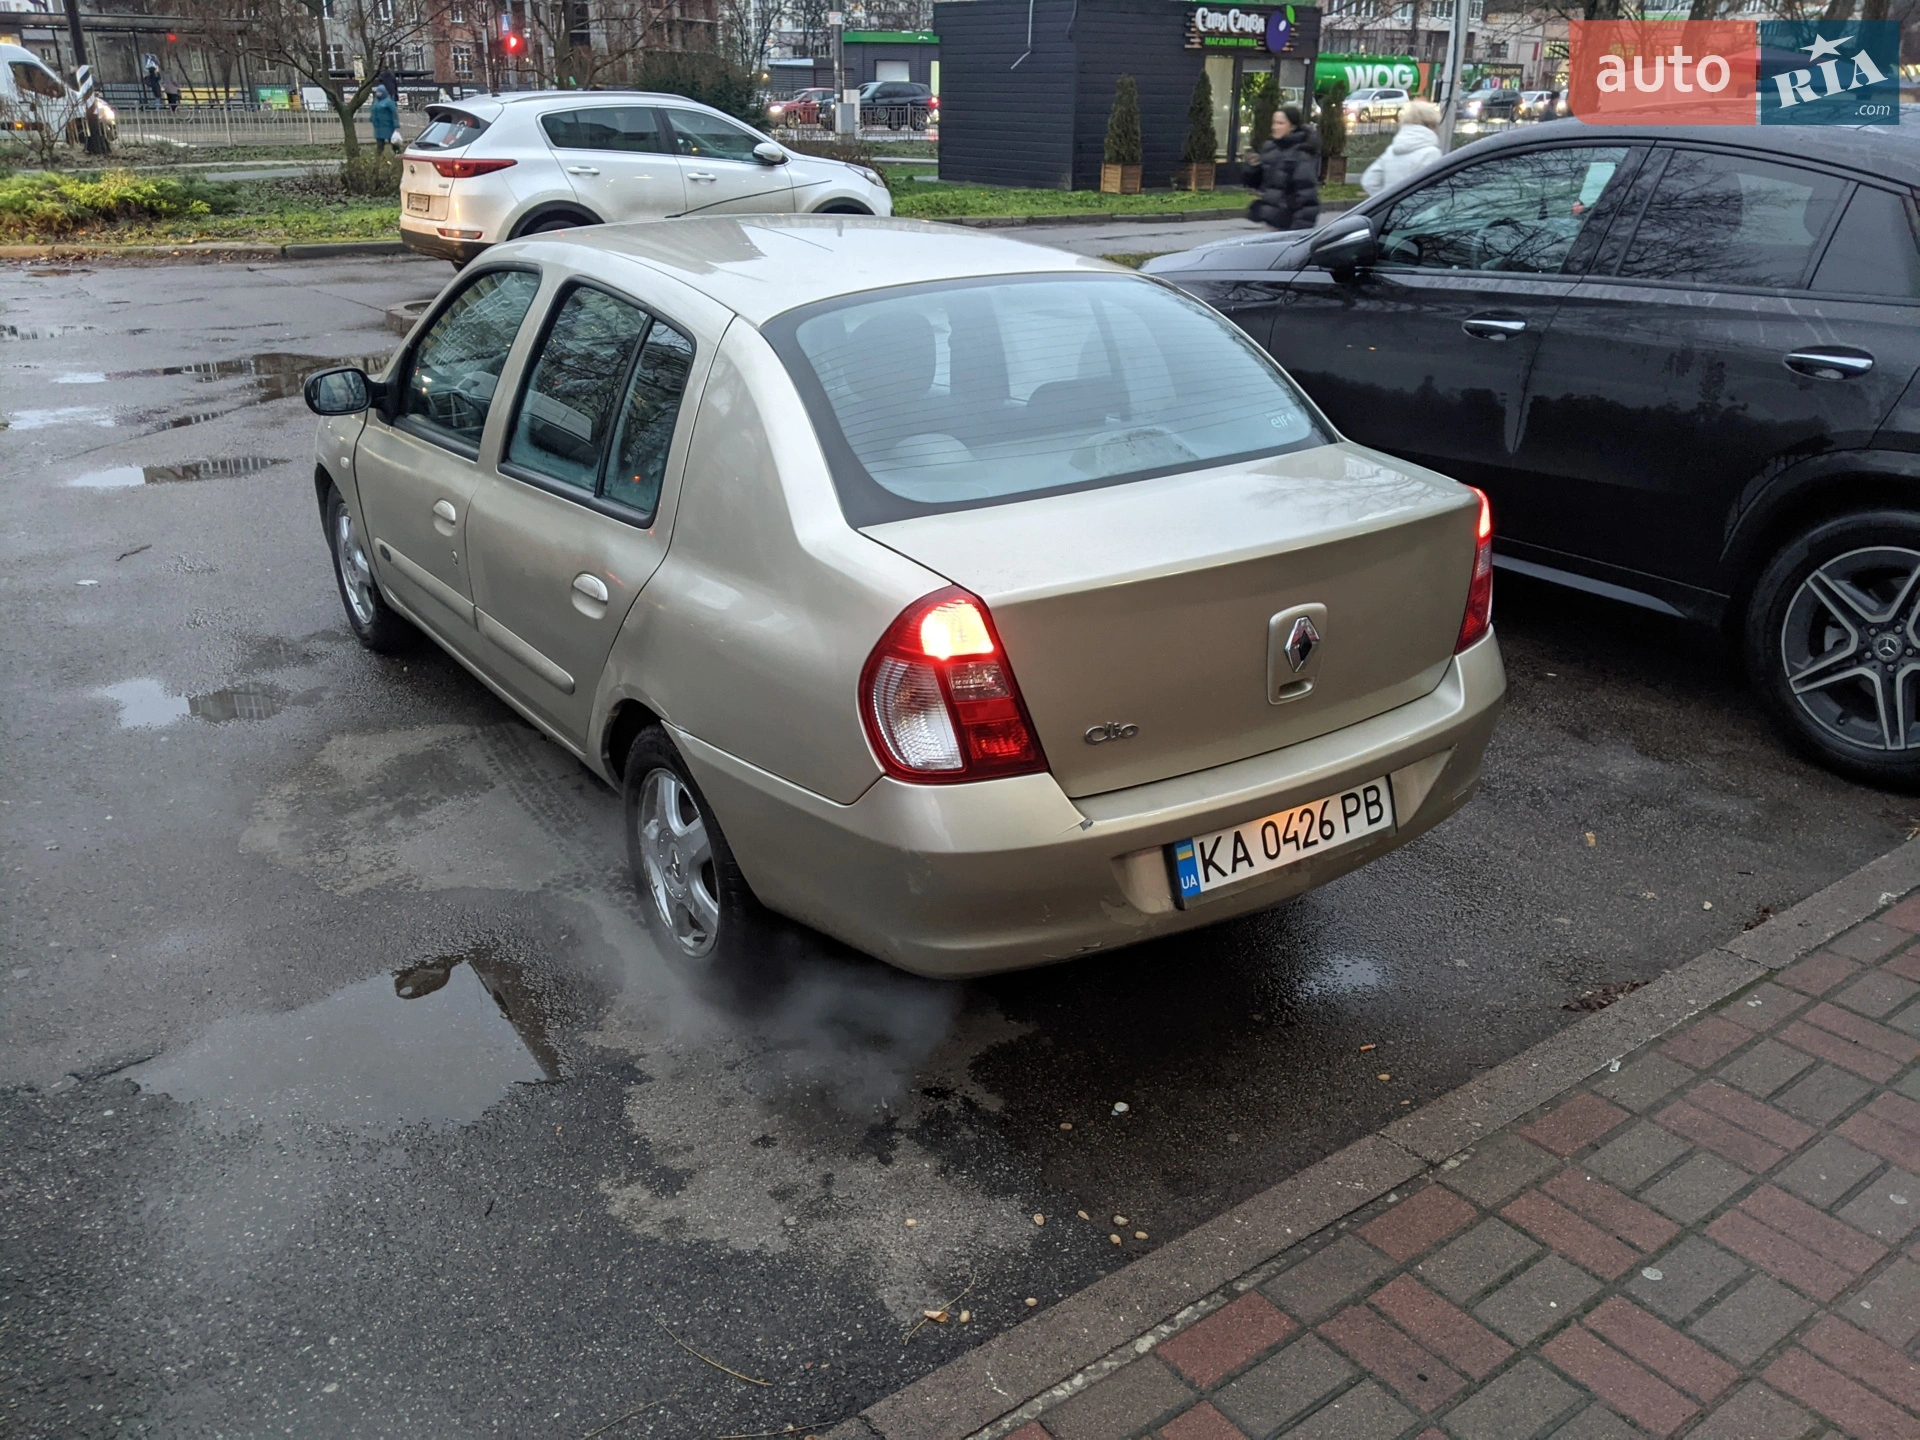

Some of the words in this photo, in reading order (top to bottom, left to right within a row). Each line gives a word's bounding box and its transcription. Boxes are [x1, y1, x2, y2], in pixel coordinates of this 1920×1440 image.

[1344, 64, 1414, 90] WOG
[1199, 830, 1254, 883] KA
[1261, 800, 1335, 860] 0426
[1341, 785, 1384, 834] PB
[1181, 874, 1198, 890] UA
